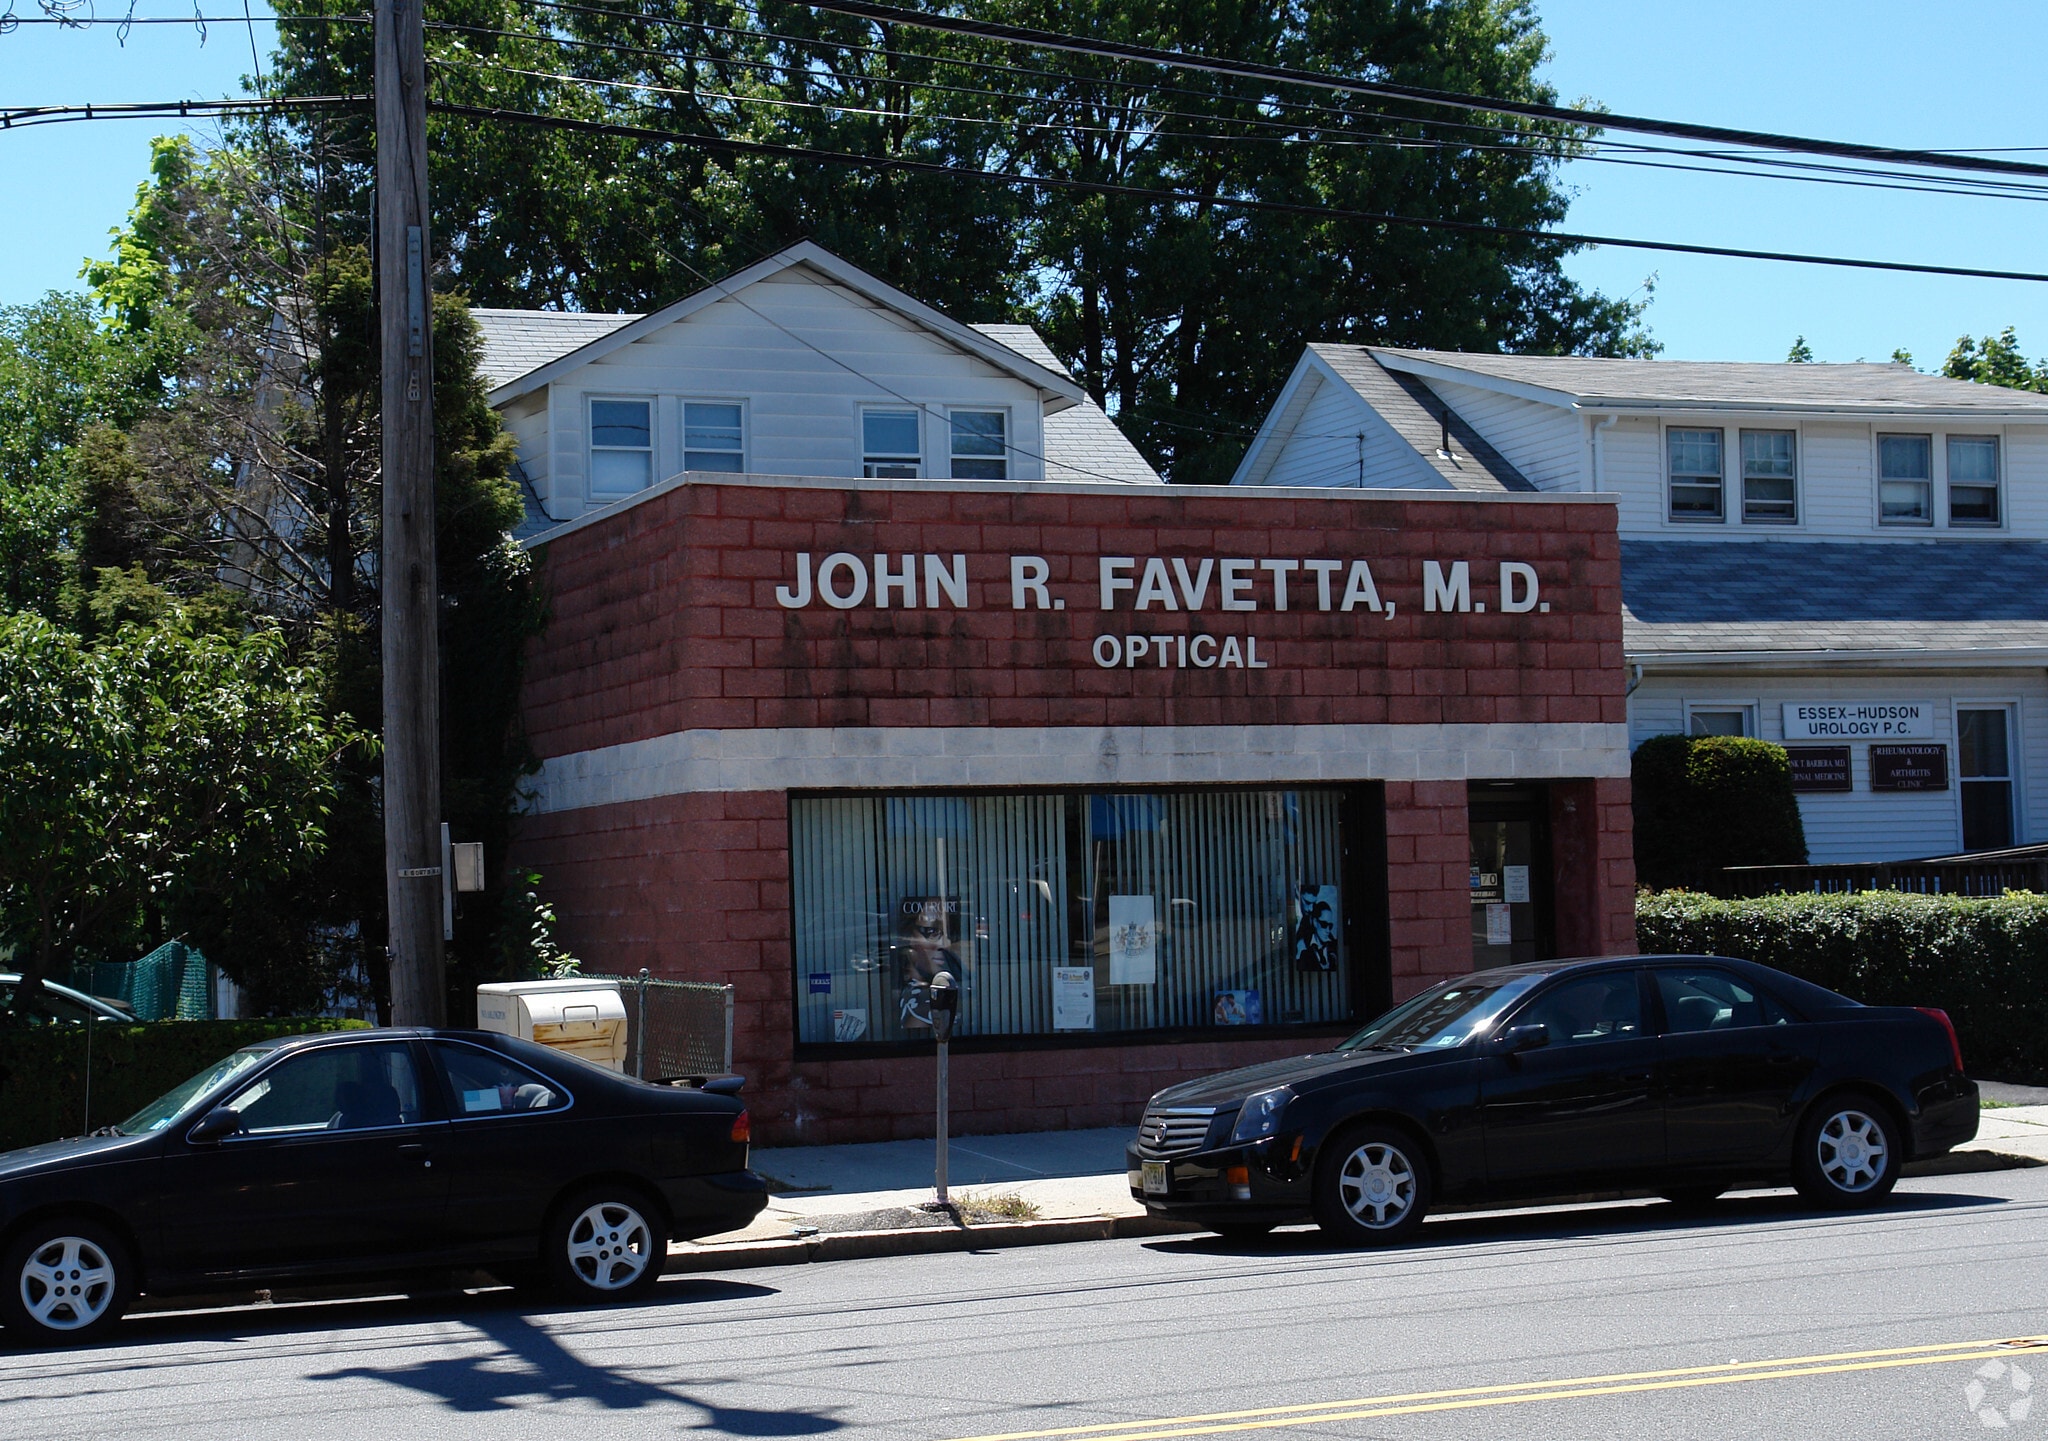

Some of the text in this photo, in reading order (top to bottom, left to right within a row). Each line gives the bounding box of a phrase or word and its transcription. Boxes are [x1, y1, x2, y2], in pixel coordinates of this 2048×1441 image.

[775, 552, 968, 609] JOHN
[1010, 556, 1065, 610] R.
[1099, 557, 1396, 621] FAVETTA,
[1092, 634, 1268, 668] OPTICAL
[1798, 706, 1919, 720] ESSEX-HUDSON
[1808, 722, 1911, 735] UROLOGY P.C.
[1876, 747, 1940, 755] RHEUMATOLOGY
[1906, 757, 1912, 766] &
[1814, 772, 1847, 781] MEDICINE
[1890, 768, 1931, 777] ARTHRITIS
[1897, 780, 1924, 789] CLINIC
